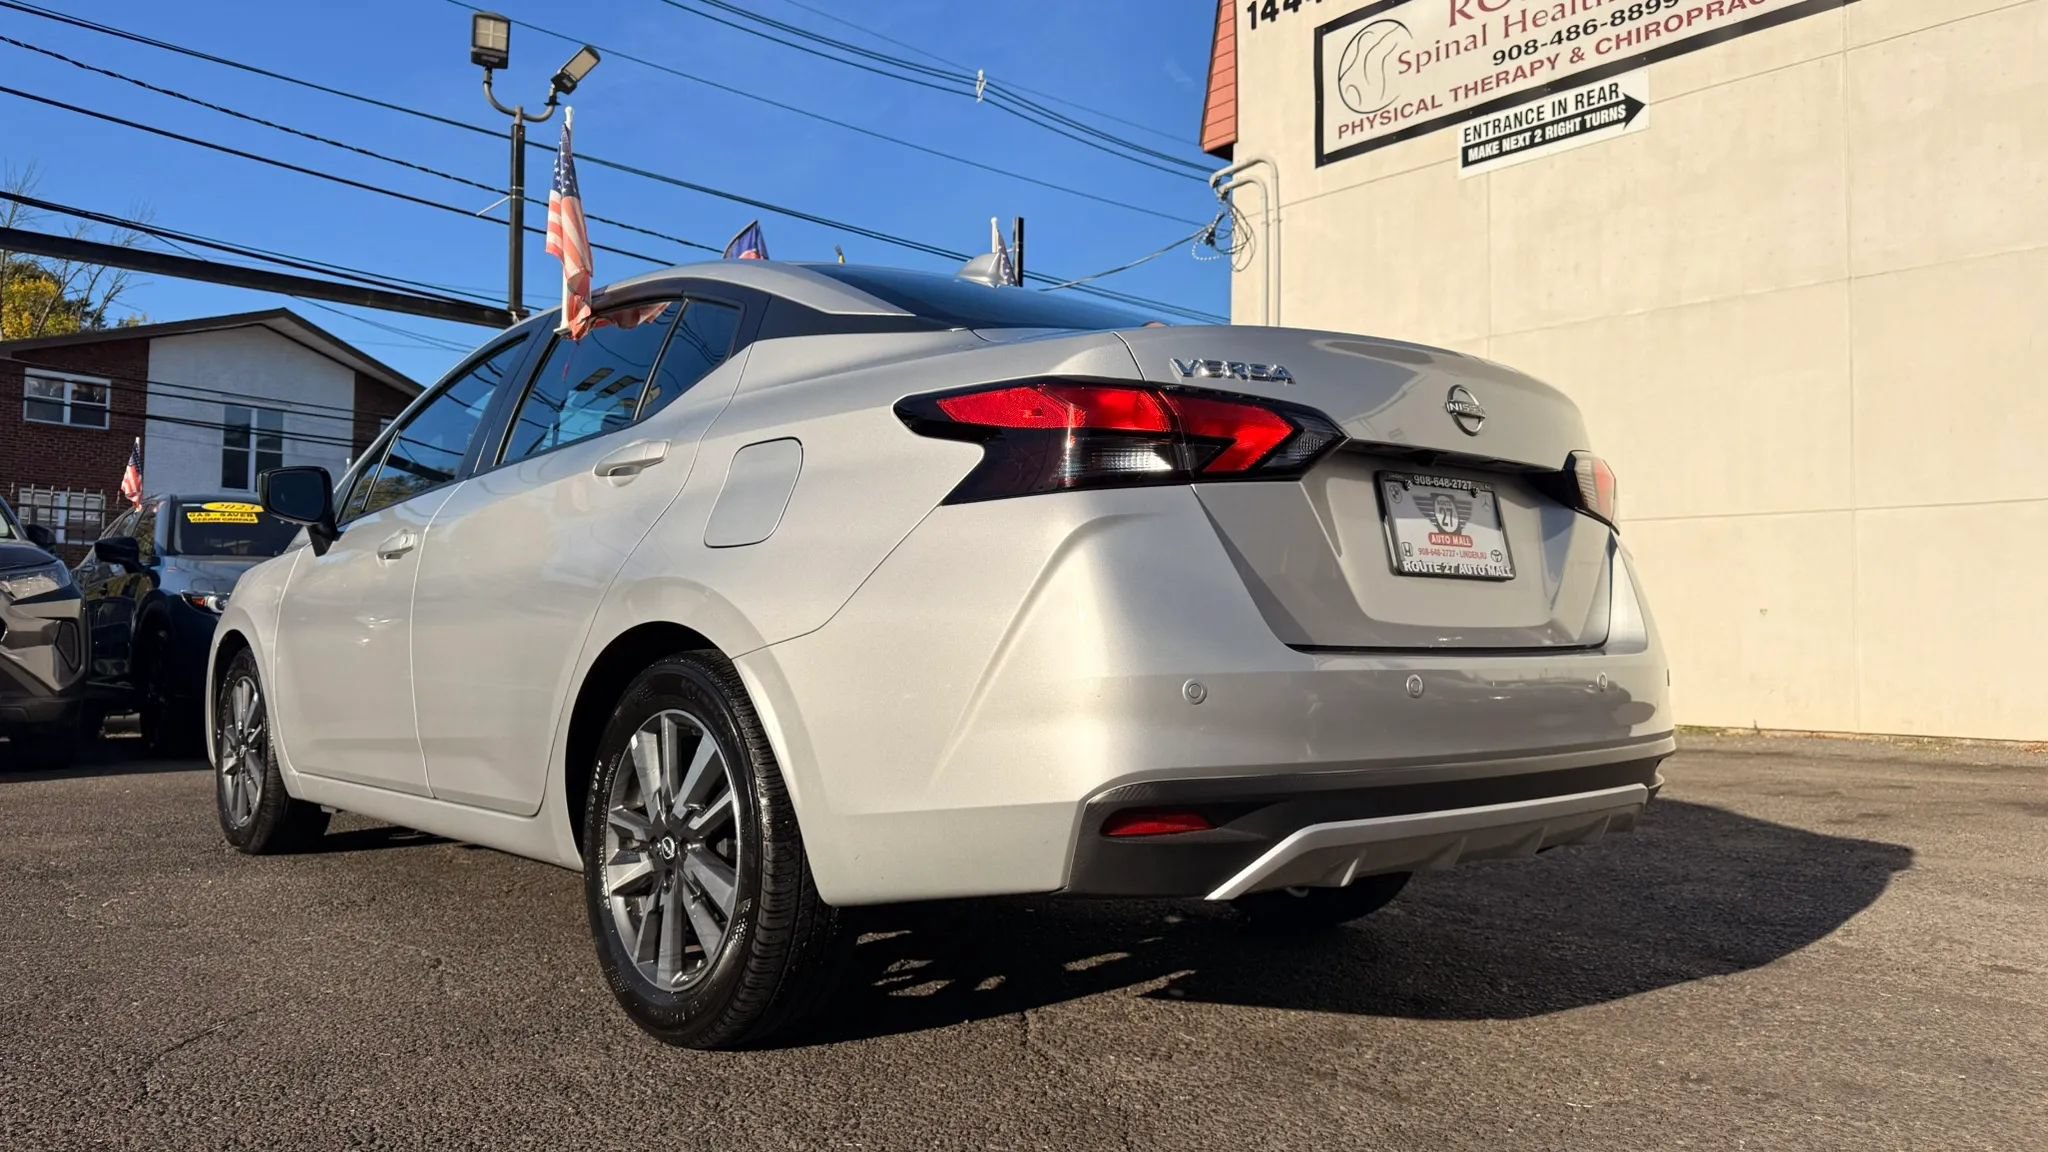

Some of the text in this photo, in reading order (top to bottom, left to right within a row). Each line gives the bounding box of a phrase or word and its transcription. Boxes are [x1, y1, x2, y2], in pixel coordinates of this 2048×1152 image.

[1397, 23, 1488, 75] Spinal
[1503, 0, 1612, 39] Healt
[1492, 0, 1679, 66] 908-486-8899
[1338, 0, 1767, 140] PHYSICAL THERAPY & CHIROPRA
[1464, 82, 1619, 144] ENTRANCE IN REAR
[1468, 104, 1627, 162] MAKE NEXT 2 RIGHT TURNS
[1168, 358, 1296, 385] VERSA
[1413, 474, 1472, 491] 908-648-2727
[1439, 507, 1454, 528] 27
[1431, 534, 1472, 547] AUTO MALL
[1402, 560, 1515, 577] ROUTE 27 AUTO MALL
